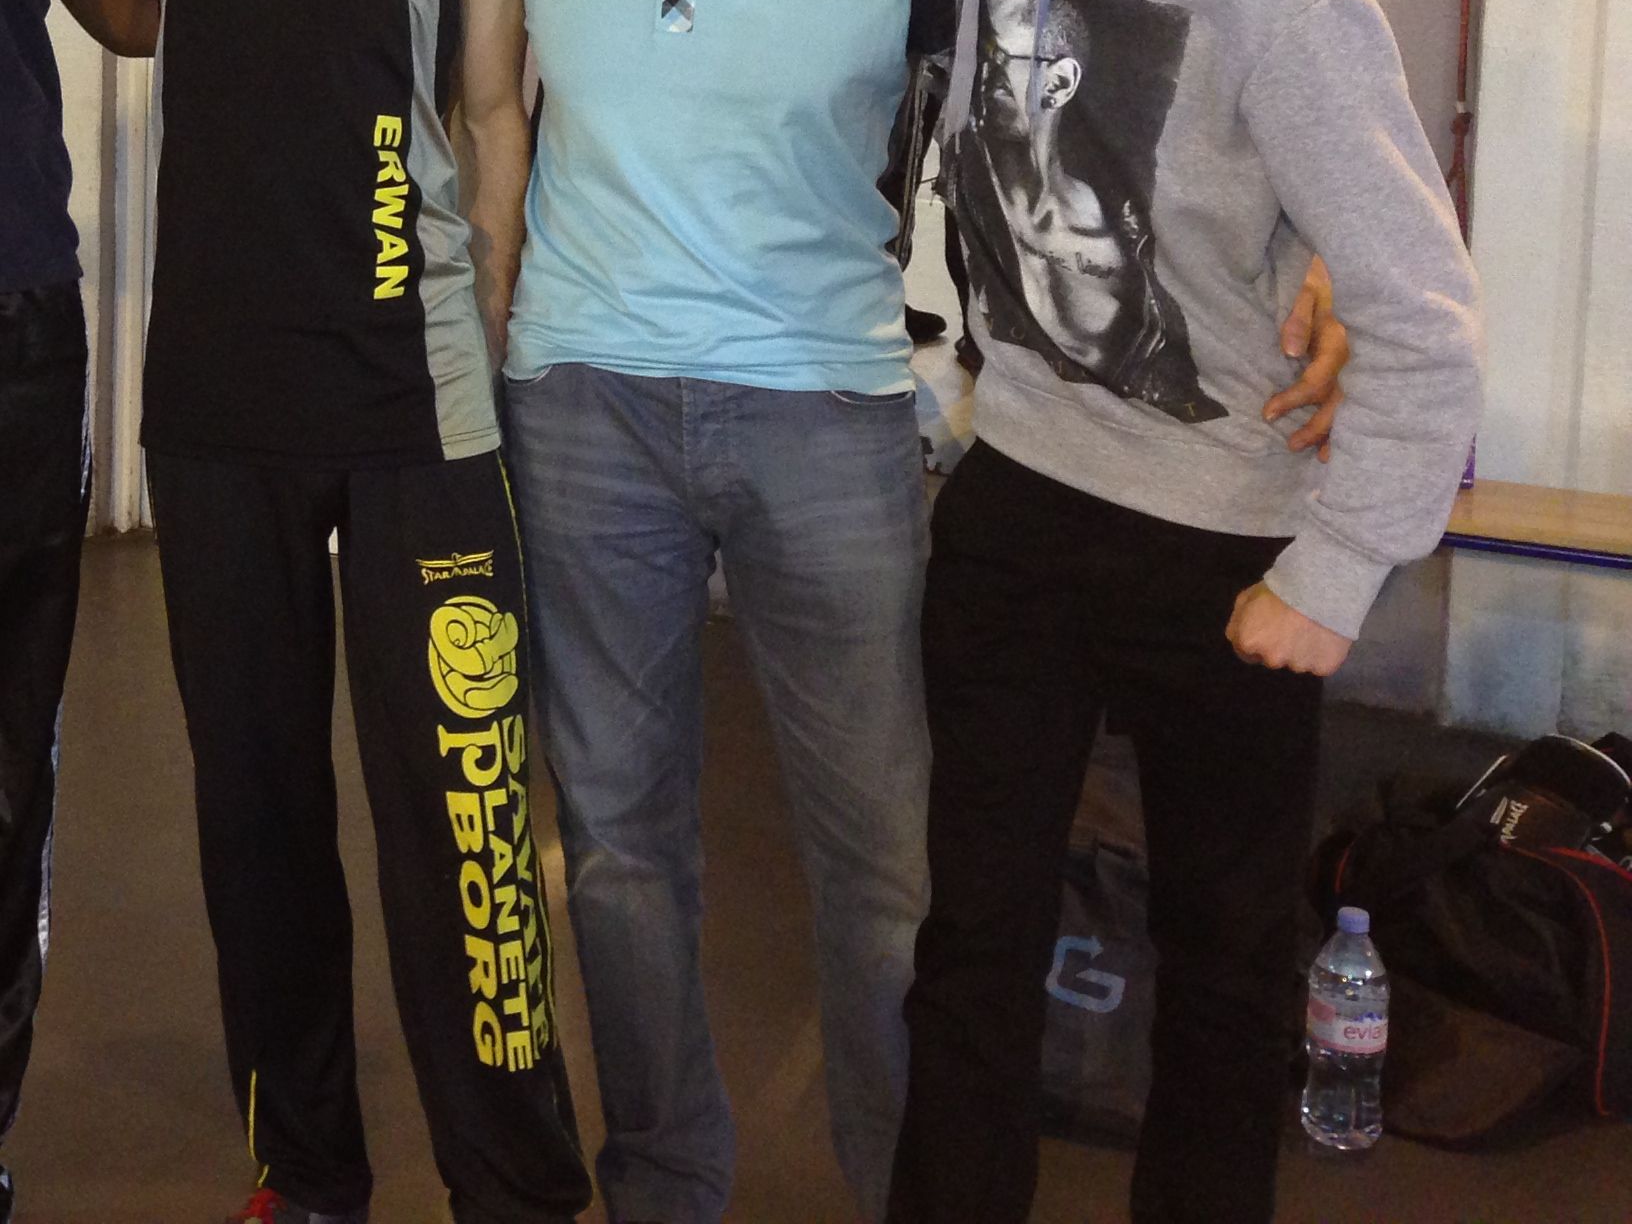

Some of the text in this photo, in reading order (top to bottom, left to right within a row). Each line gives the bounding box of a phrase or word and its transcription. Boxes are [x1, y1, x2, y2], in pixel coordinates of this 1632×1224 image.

[372, 114, 410, 299] ERWAN
[445, 790, 504, 1068] BORG
[1344, 1024, 1387, 1041] evia
